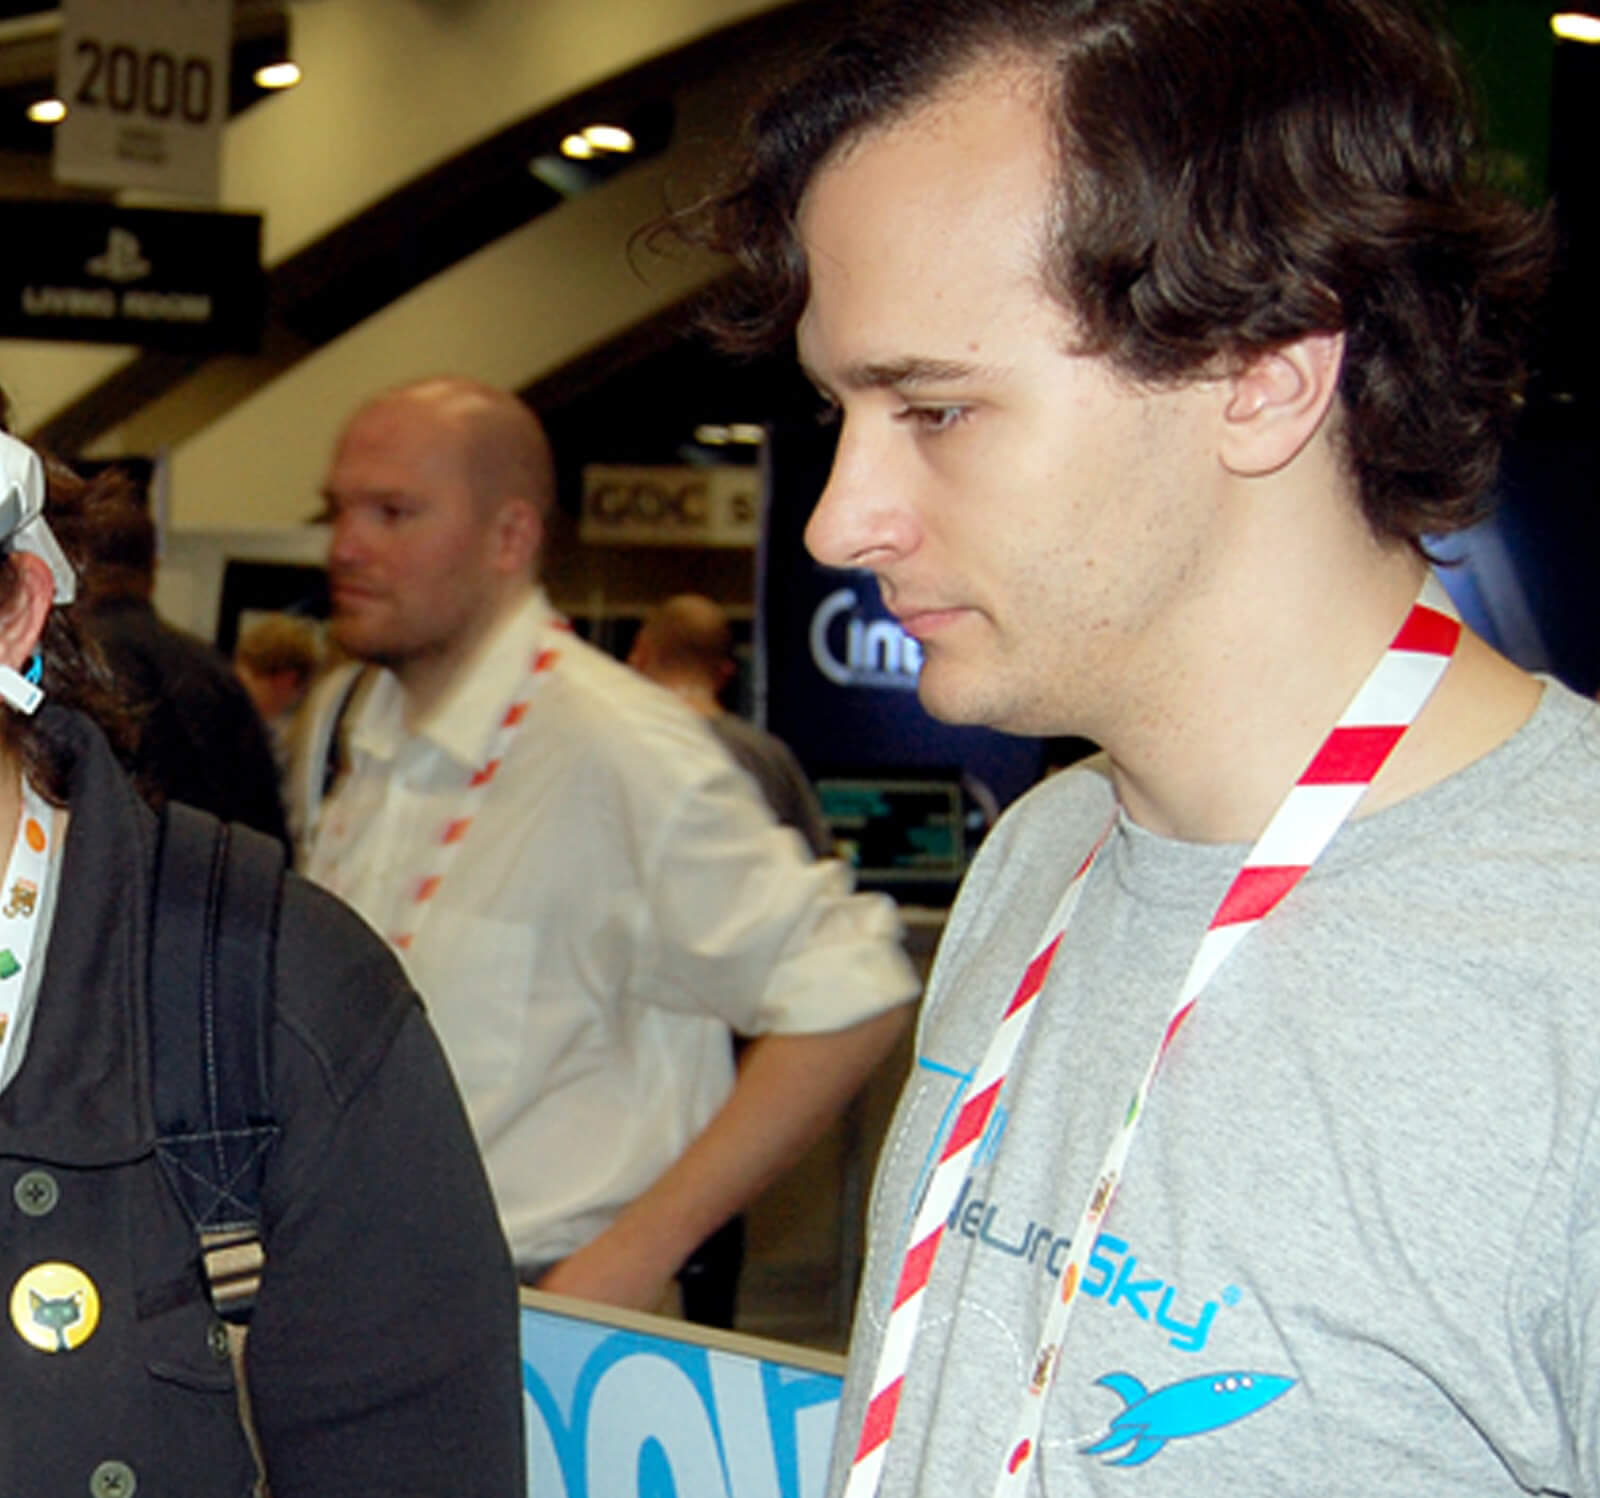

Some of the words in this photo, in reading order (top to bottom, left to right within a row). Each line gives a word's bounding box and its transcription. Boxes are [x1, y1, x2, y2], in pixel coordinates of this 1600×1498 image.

[76, 39, 212, 124] 2000
[21, 285, 116, 318] LIVING
[122, 289, 212, 322] ROOM
